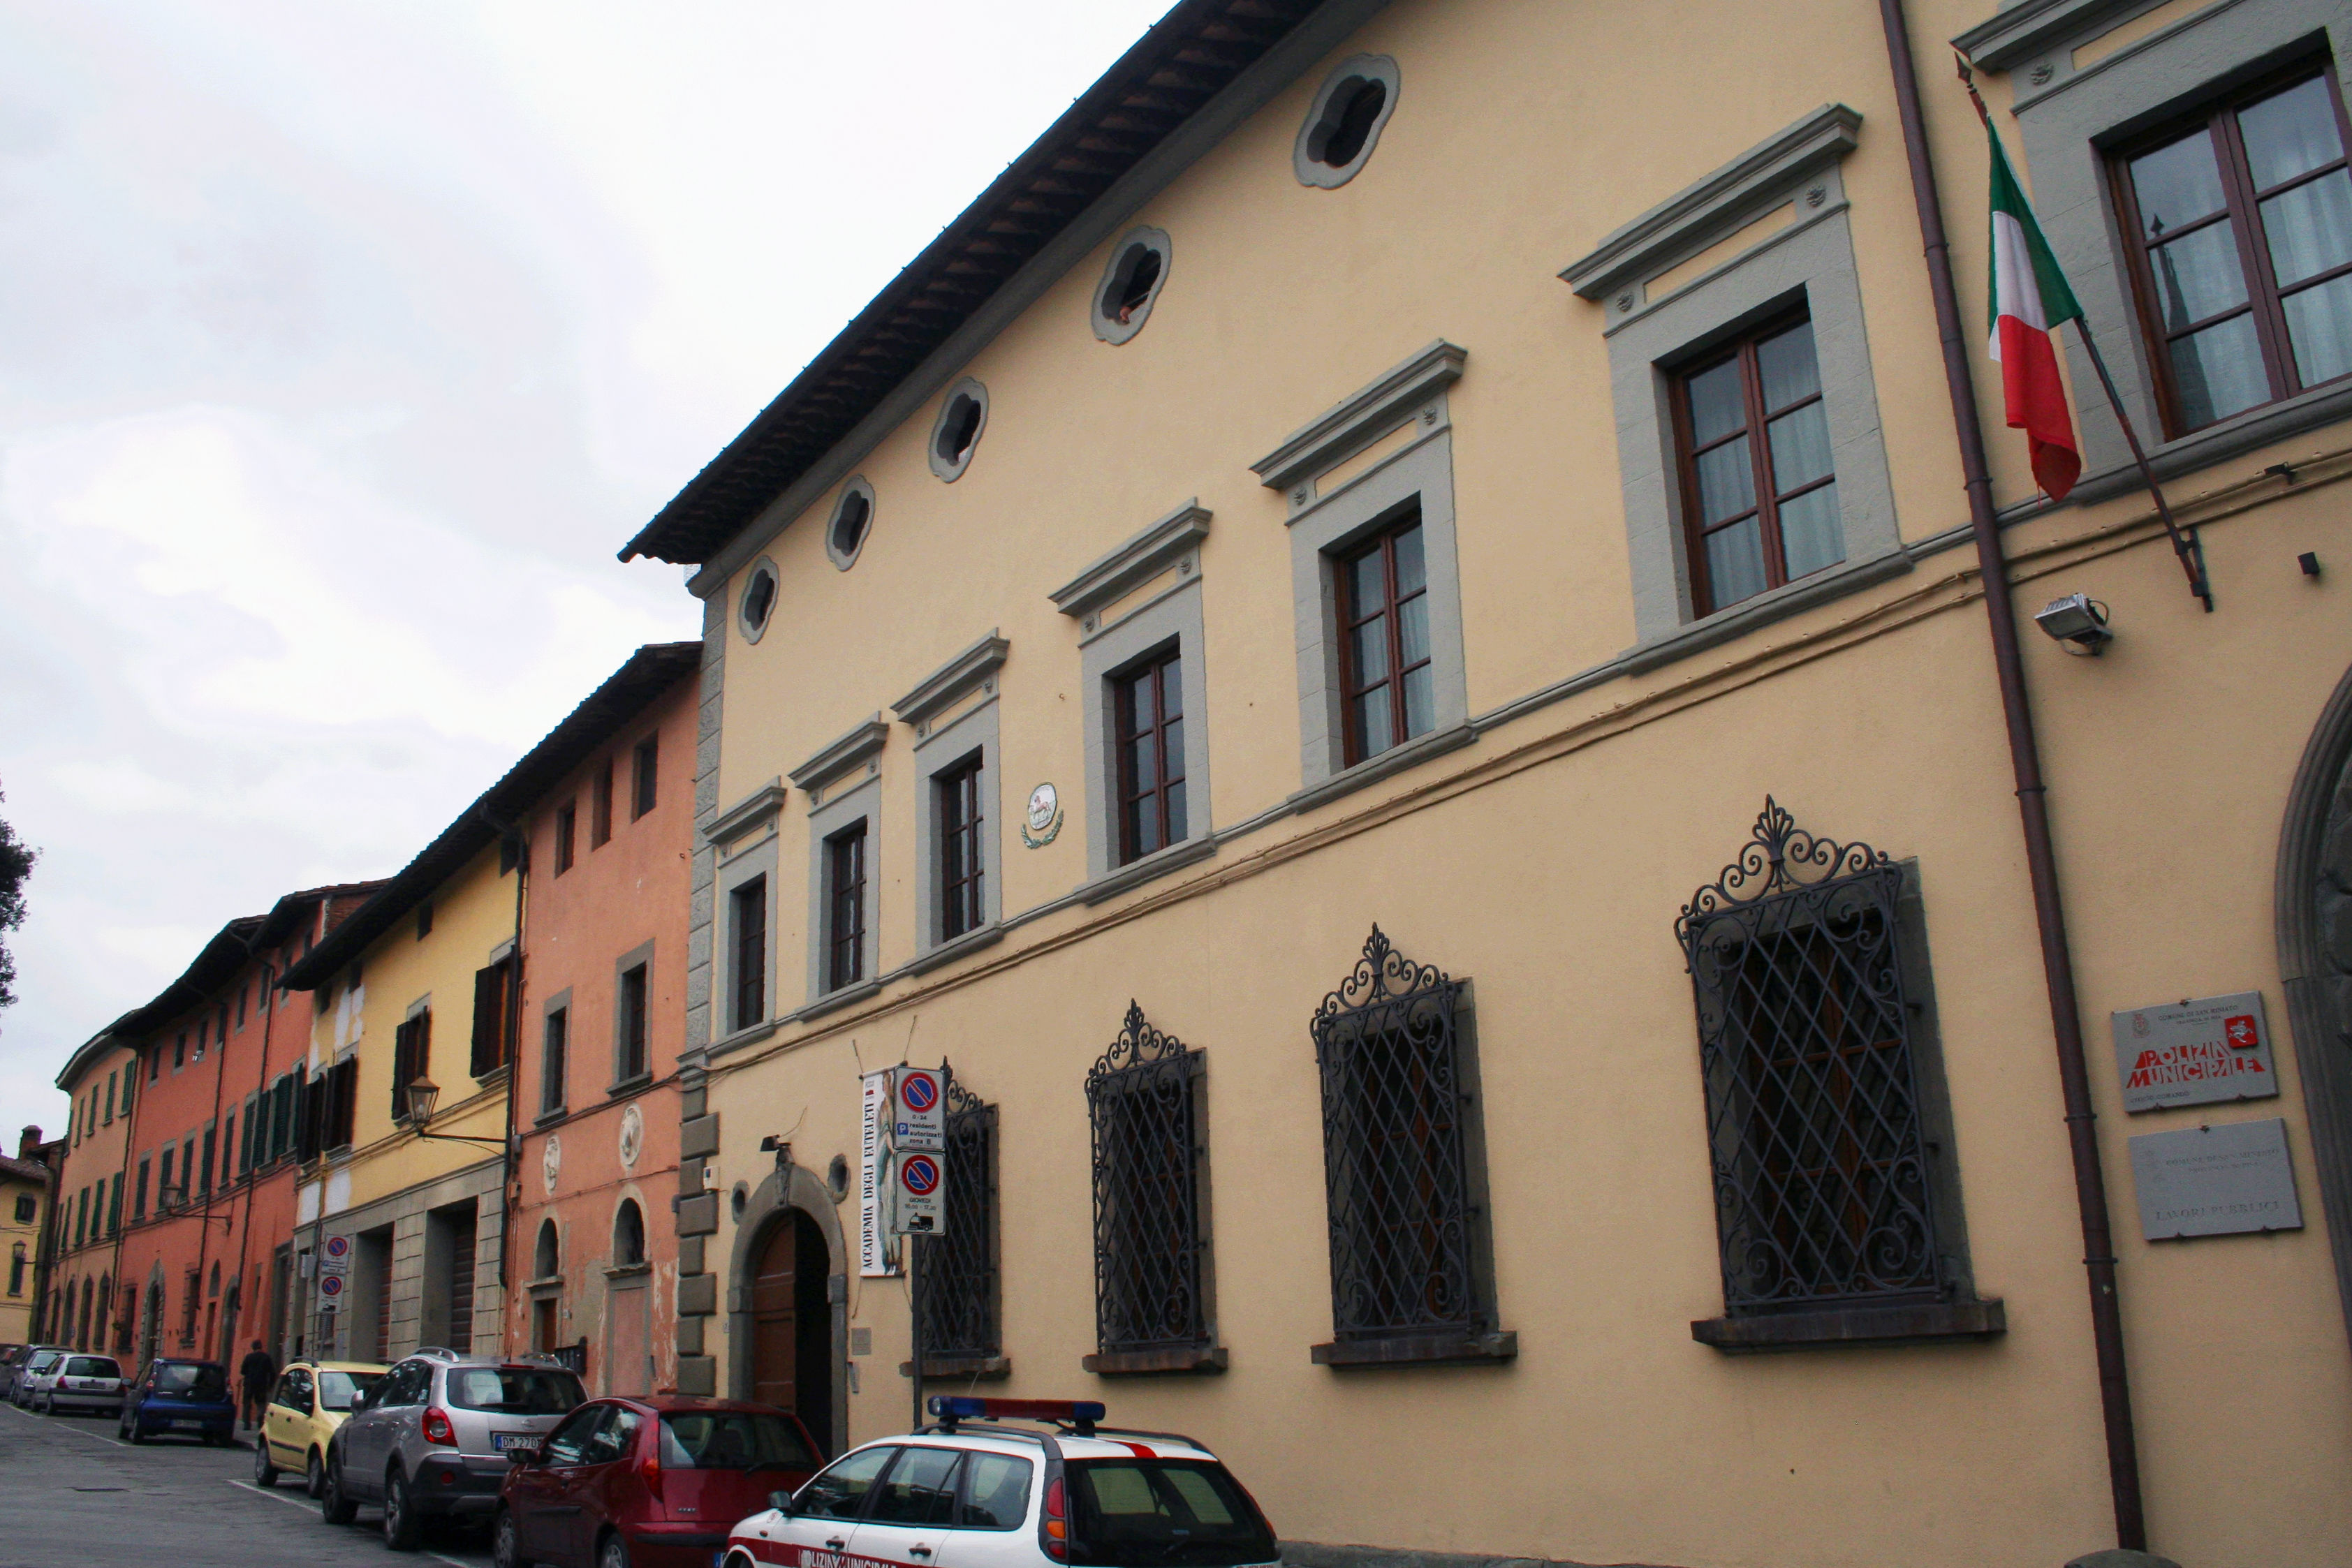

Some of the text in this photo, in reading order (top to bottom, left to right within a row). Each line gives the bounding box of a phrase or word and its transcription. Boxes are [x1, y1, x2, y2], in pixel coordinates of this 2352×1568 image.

[2135, 1041, 2231, 1069] POLIZIA
[2126, 1057, 2265, 1089] MUNICIPALE
[864, 1103, 874, 1157] EUTELETI
[863, 1164, 874, 1199] DEGLI
[862, 1206, 873, 1269] ACCADEMIA
[798, 1549, 835, 1568] LIZIA
